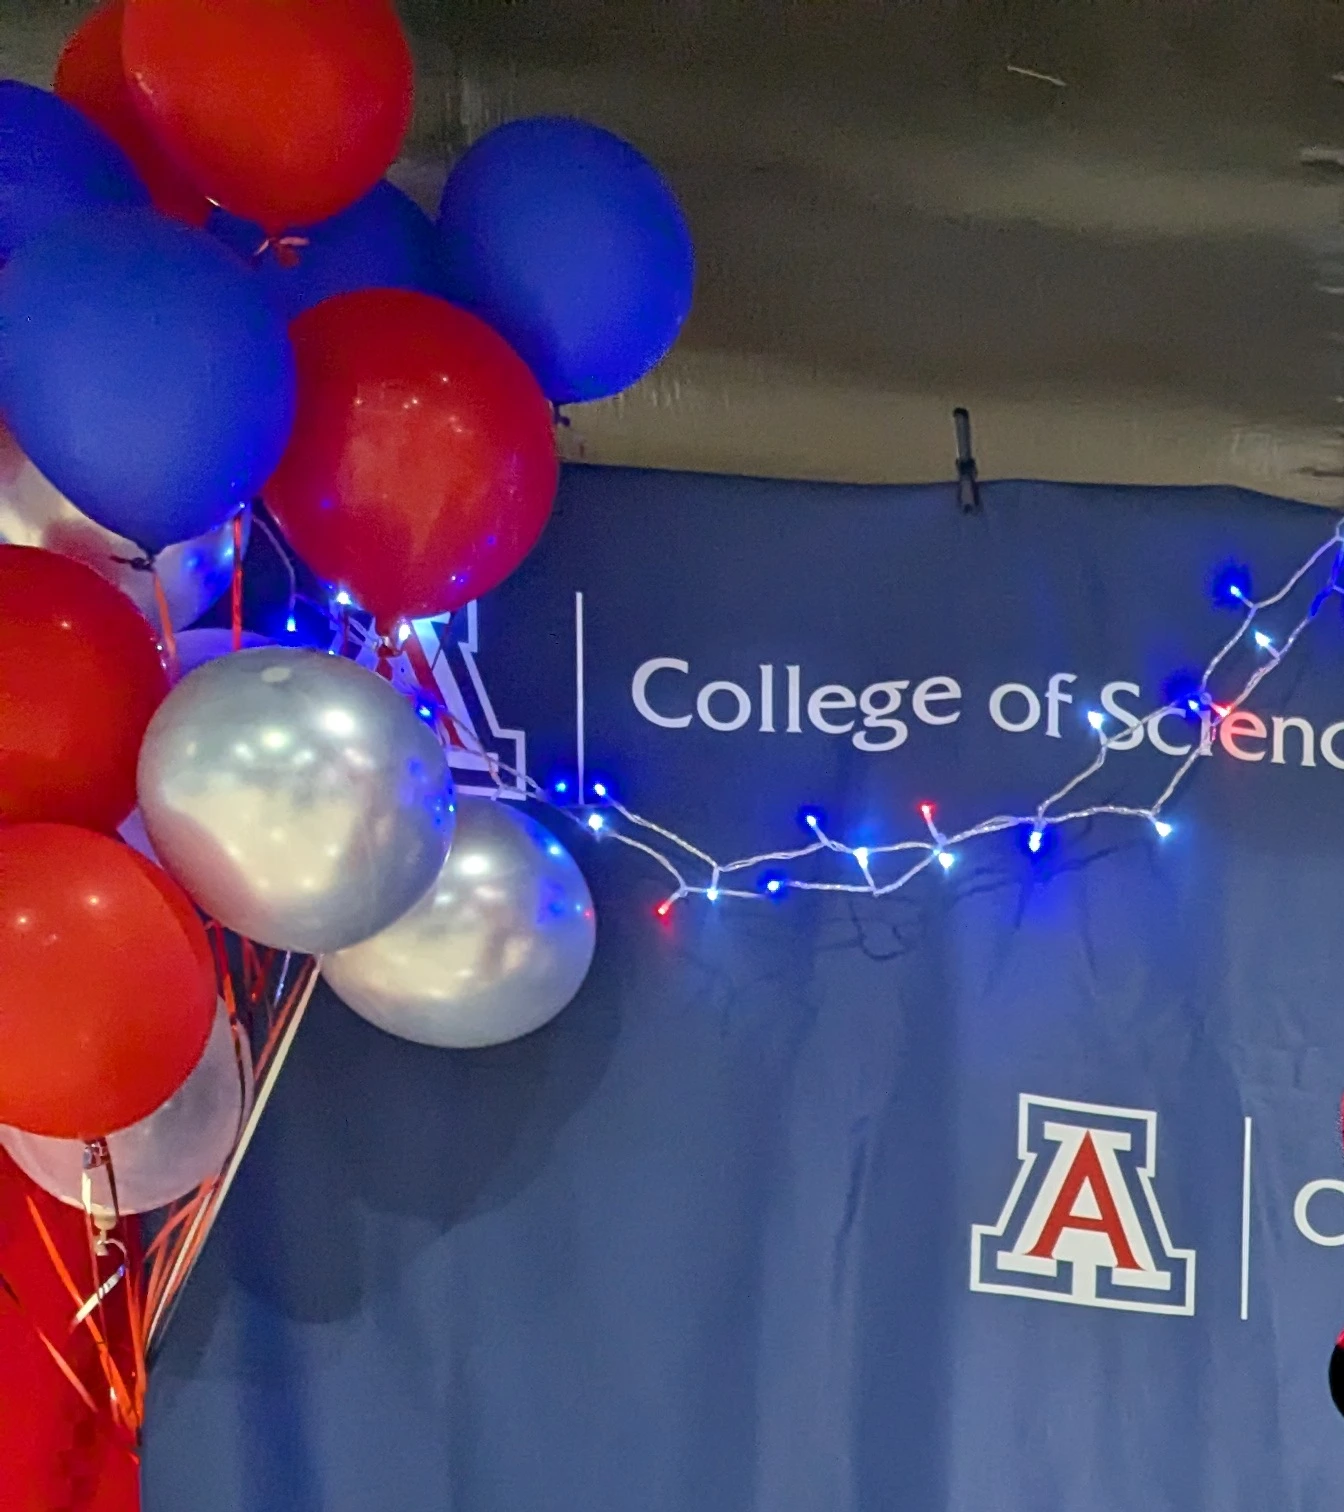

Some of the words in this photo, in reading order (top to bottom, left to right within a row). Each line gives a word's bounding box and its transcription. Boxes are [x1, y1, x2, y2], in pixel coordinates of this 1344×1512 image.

[632, 656, 962, 752] College
[988, 672, 1078, 739] of
[970, 1093, 1196, 1316] A
